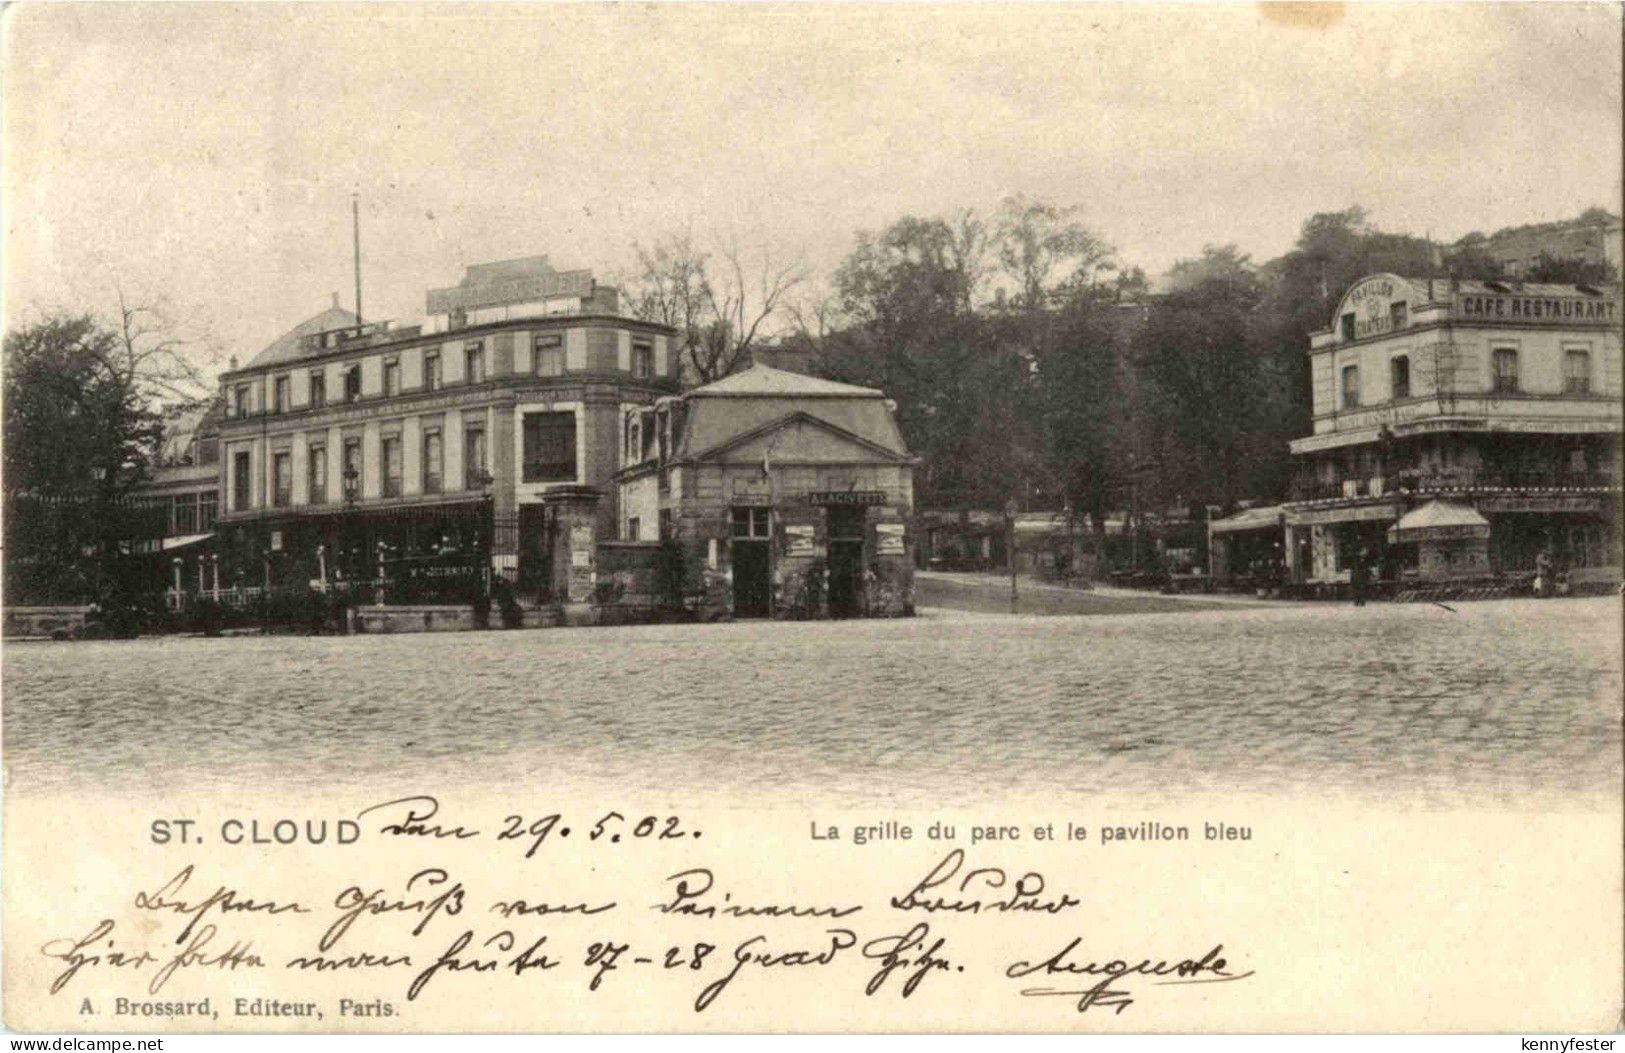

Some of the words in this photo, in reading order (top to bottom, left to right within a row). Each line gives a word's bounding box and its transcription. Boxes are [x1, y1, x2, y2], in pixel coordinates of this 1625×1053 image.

[1512, 299, 1615, 320] RESTAURANT
[150, 819, 206, 845] ST.
[221, 819, 361, 845] CLOUD
[811, 820, 841, 842] La
[854, 820, 914, 847] grille
[927, 820, 957, 842] du
[972, 826, 1021, 847] parc
[1034, 823, 1056, 842] et
[1068, 822, 1088, 842] le
[1102, 821, 1190, 847] pavillon
[1205, 821, 1253, 842] bleu
[115, 998, 219, 1021] Brossard,
[234, 998, 324, 1021] Editeur,
[339, 998, 400, 1018] Paris.
